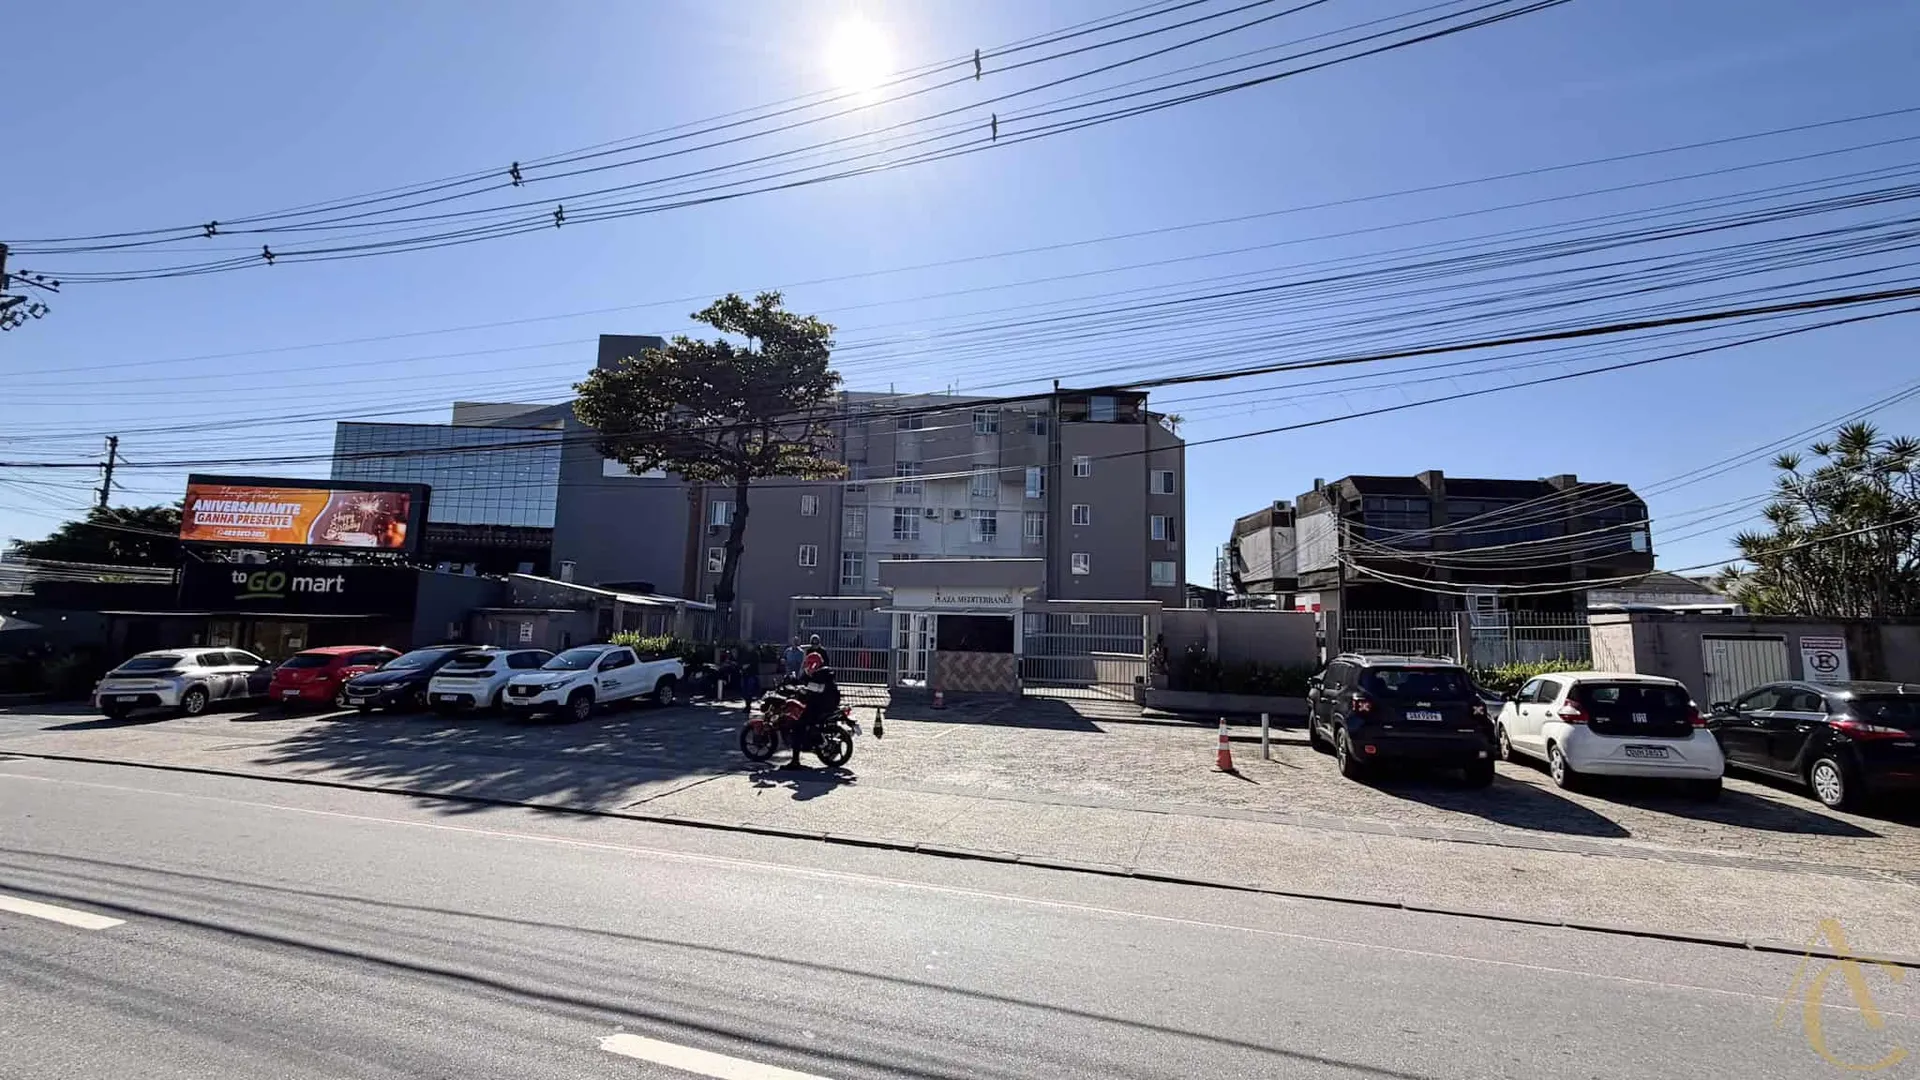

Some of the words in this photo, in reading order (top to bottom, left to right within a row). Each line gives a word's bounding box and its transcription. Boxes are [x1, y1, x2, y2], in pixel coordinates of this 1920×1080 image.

[192, 499, 301, 515] ANIVERSARIANTE
[197, 513, 234, 524] GANHA
[236, 515, 290, 526] PRESENTE
[291, 575, 345, 593] mart
